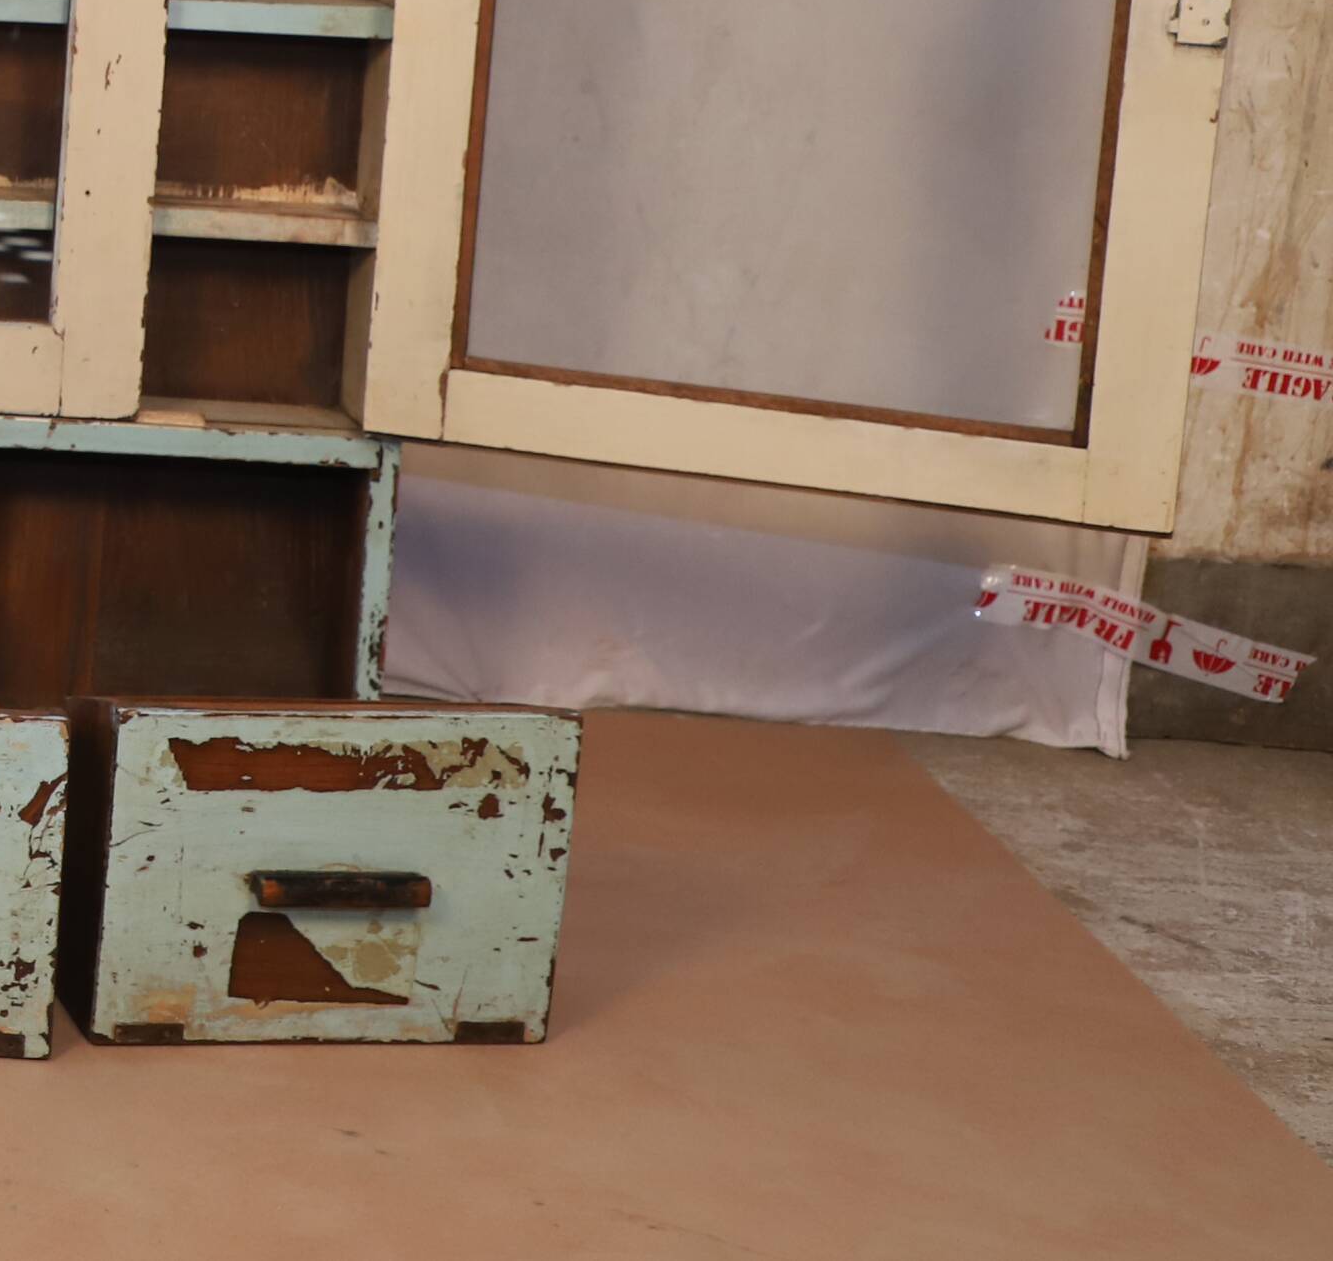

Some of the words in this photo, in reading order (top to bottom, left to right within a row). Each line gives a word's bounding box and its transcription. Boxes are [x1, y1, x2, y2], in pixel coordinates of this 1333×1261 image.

[1236, 341, 1277, 360] CARE
[1282, 350, 1324, 367] WITH
[1242, 367, 1333, 401] AGILE
[1011, 573, 1055, 591] CARE
[1060, 581, 1095, 600] WITH
[1098, 595, 1156, 625] HANDLE
